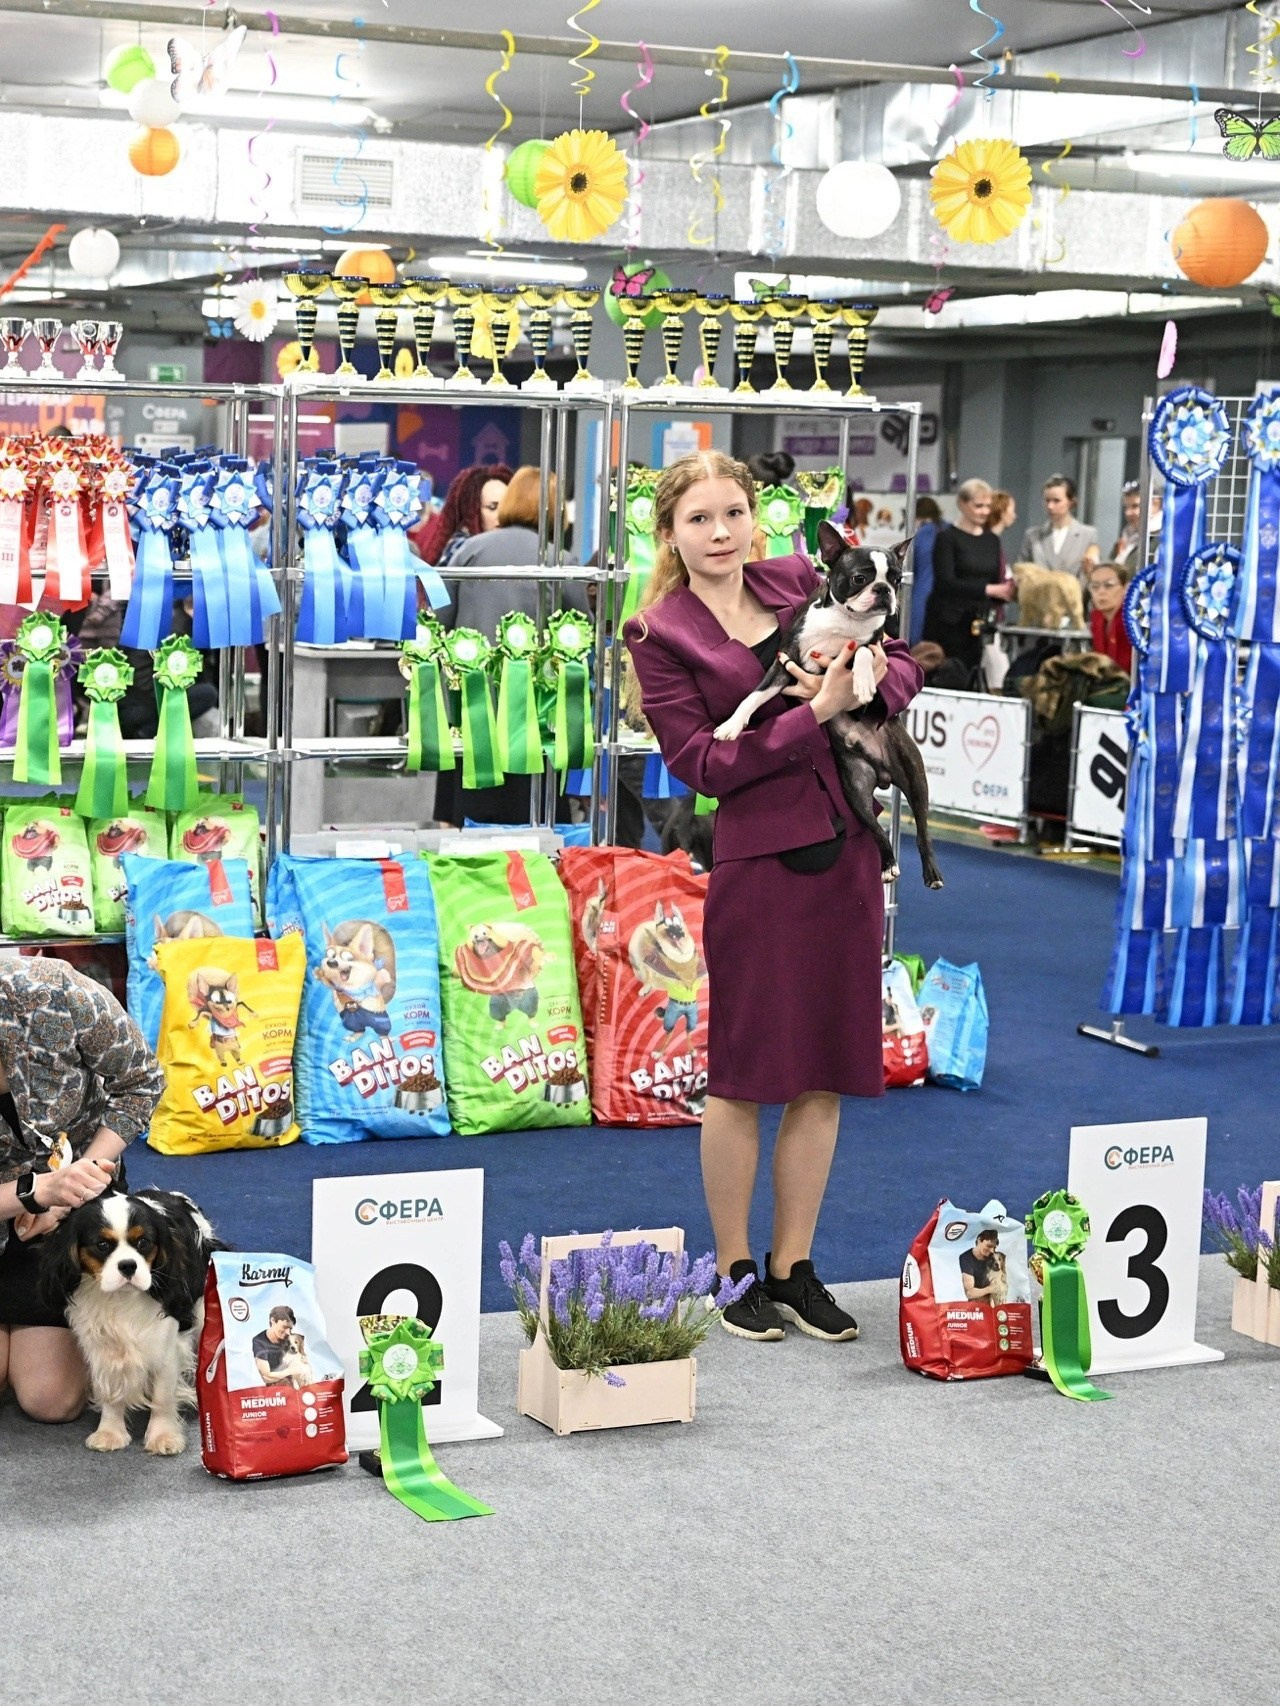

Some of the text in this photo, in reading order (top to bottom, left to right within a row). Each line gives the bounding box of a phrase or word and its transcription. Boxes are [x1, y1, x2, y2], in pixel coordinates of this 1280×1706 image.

[972, 780, 1008, 797] СФЕРА
[403, 1010, 431, 1019] КОРМ
[547, 1005, 572, 1017] КОРМ
[262, 1029, 293, 1040] КОРМ
[328, 1036, 395, 1087] BAN
[480, 1033, 544, 1084] BAN
[503, 1048, 578, 1095] DITOS
[630, 1053, 696, 1094] BAN
[191, 1064, 258, 1114] BAN
[352, 1053, 435, 1099] DITOS
[651, 1069, 708, 1100] DITO
[215, 1079, 291, 1126] DITOS
[1103, 1144, 1175, 1170] СФЕРА
[355, 1198, 444, 1225] СФЕРА
[239, 1263, 294, 1288] Karmy
[1097, 1204, 1170, 1340] 3
[946, 1310, 985, 1321] MEDIUM
[351, 1262, 443, 1413] 2
[905, 1322, 918, 1358] MEDIUM
[241, 1396, 287, 1410] MEDIUM
[241, 1410, 268, 1419] JUNIOR
[205, 1412, 215, 1453] MEDIUM
